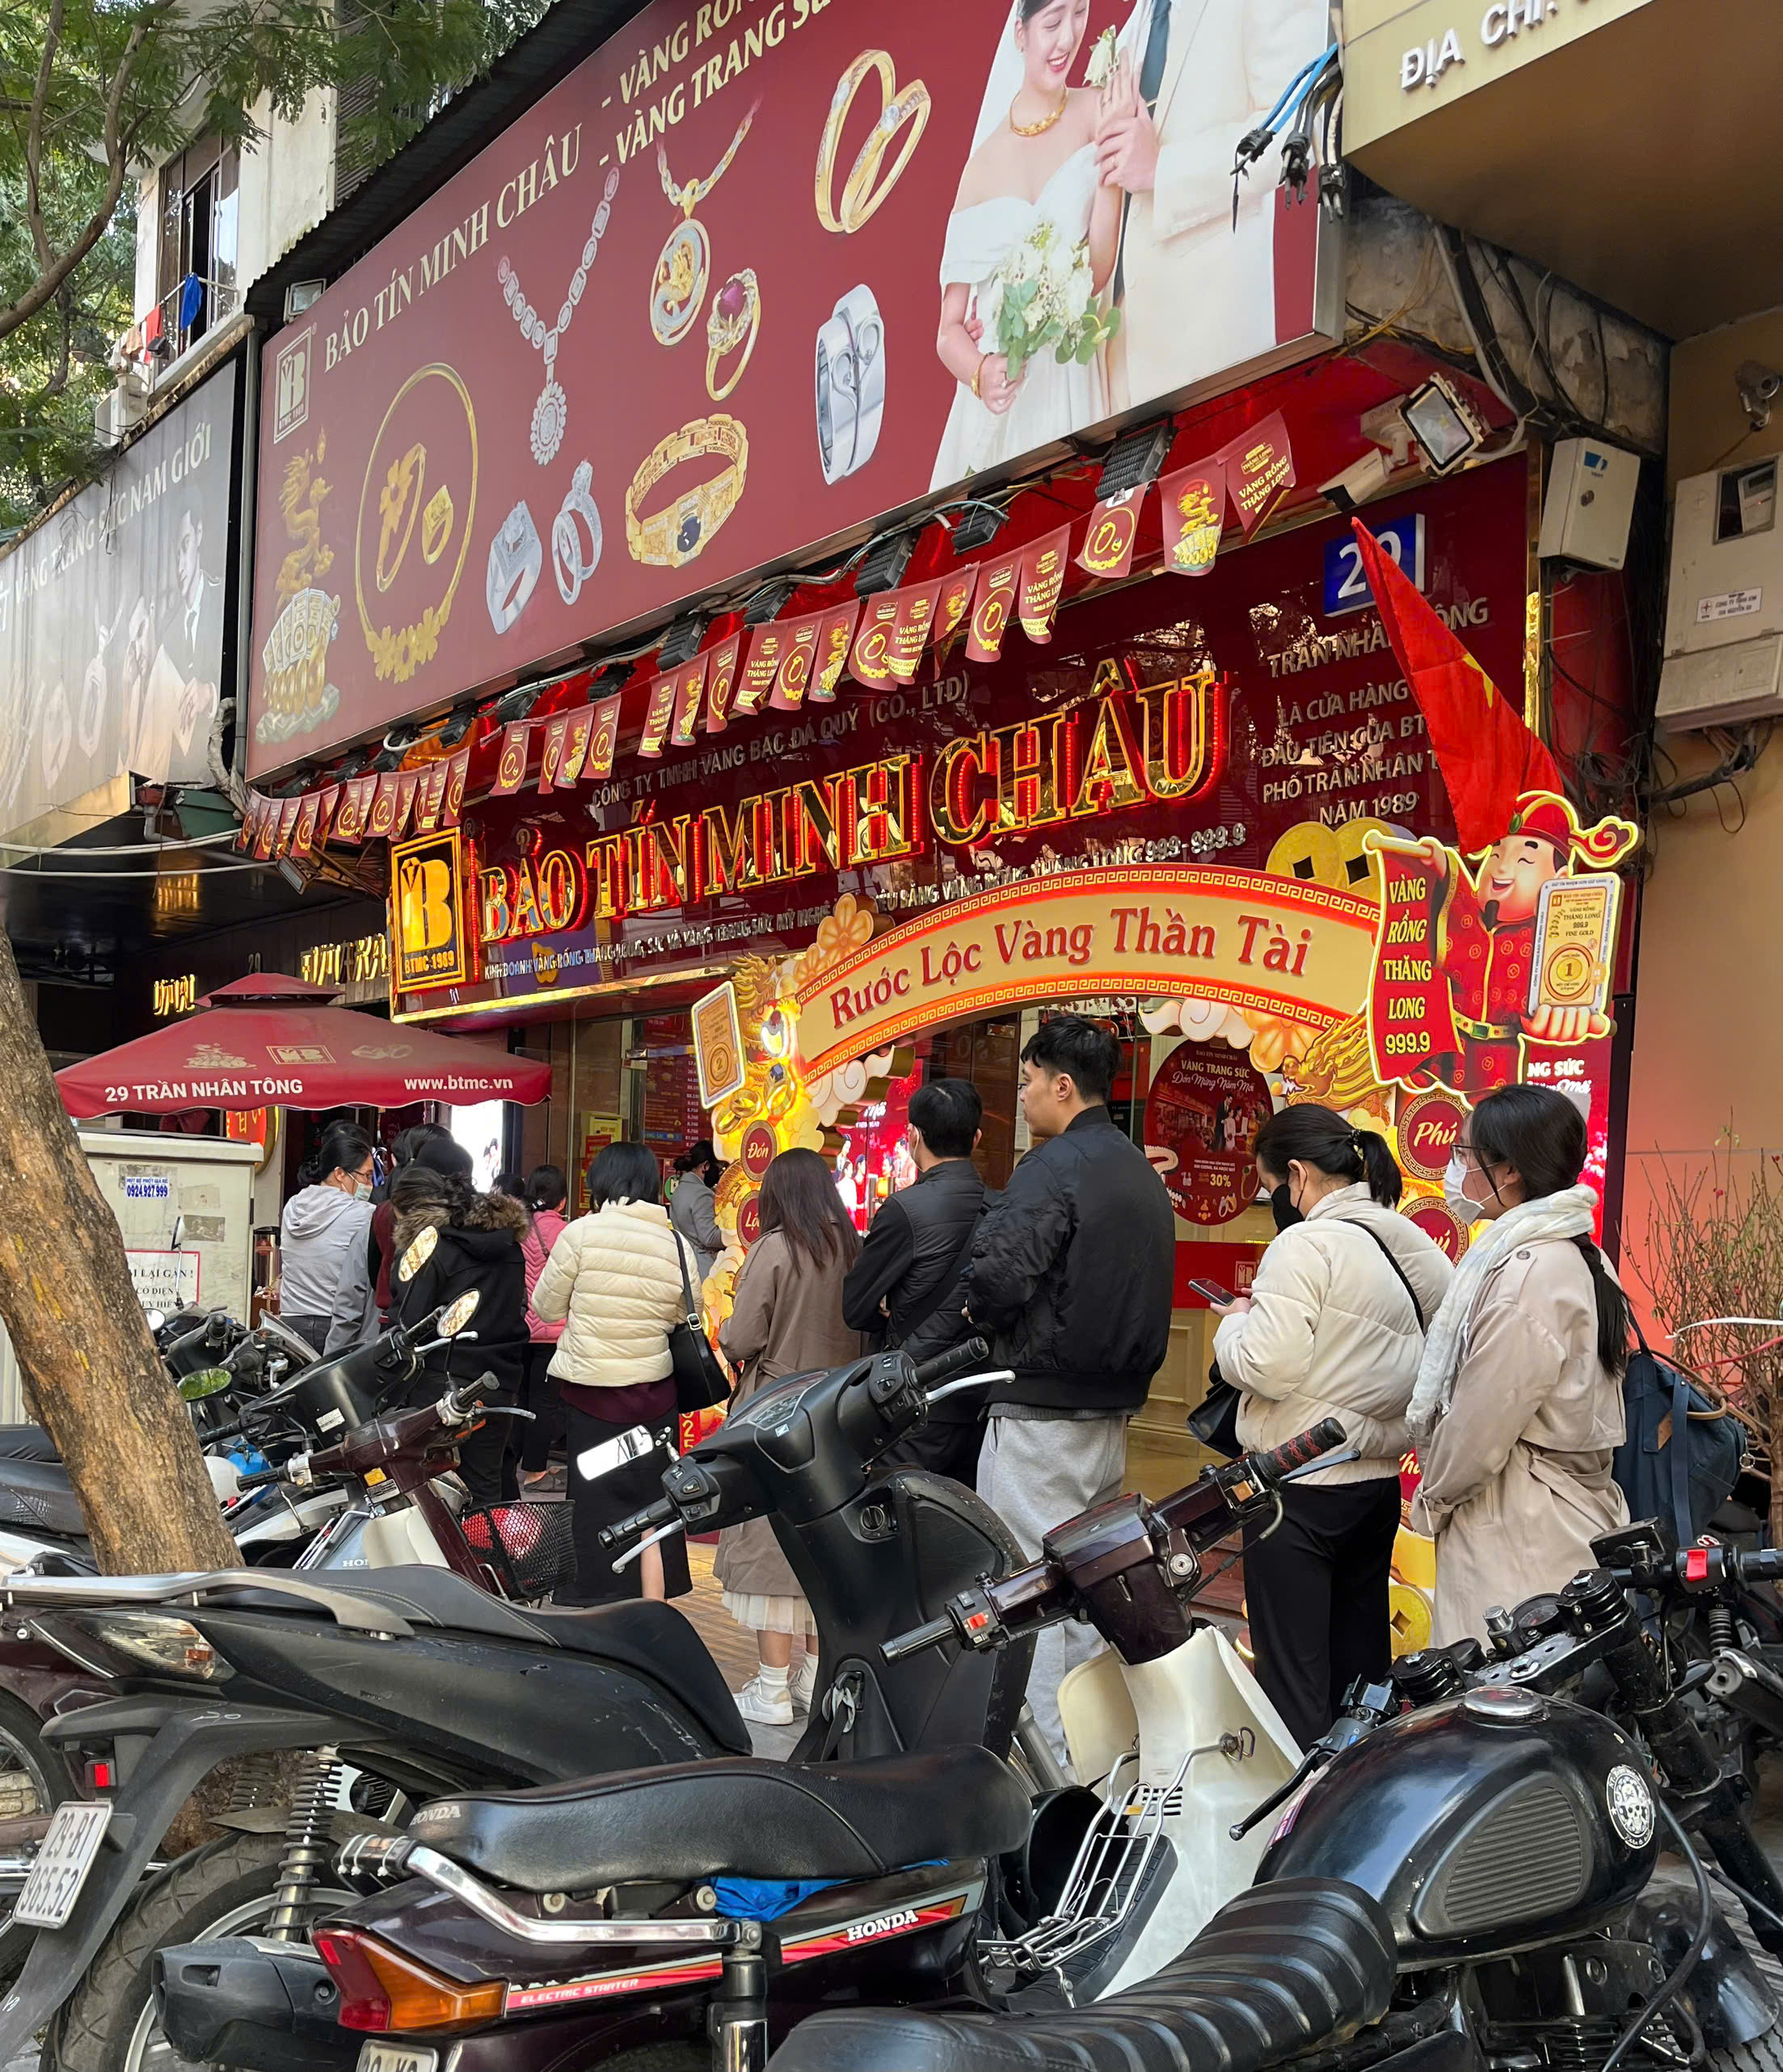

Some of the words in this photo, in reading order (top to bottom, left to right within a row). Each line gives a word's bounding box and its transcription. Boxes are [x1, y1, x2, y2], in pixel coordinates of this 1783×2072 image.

[620, 20, 689, 104] VÀNG
[1399, 28, 1465, 91] ĐỊA
[616, 82, 685, 164] VÀNG
[691, 2, 786, 108] TRANG
[324, 307, 369, 373] BẢO
[373, 265, 414, 331] TÍN
[419, 200, 491, 297] MINH
[496, 122, 583, 228] CHÂU
[130, 460, 167, 517] NAM
[171, 423, 212, 484] GIỚI
[1238, 476, 1265, 499] VÀNG
[1265, 455, 1287, 480] RỒNG
[1241, 484, 1271, 511] THĂNG
[1271, 463, 1290, 487] LONG
[1024, 590, 1051, 604] THĂNG
[1051, 583, 1061, 596] LON
[1027, 580, 1048, 594] VÀNG
[895, 634, 918, 644] THĂNG
[899, 625, 917, 635] VÀNG
[1267, 634, 1329, 678] TRẦN
[1335, 621, 1392, 660] NHÂ
[1440, 596, 1489, 632] ÔNG
[751, 659, 766, 668] VÀNG
[1281, 701, 1303, 728] LÀ
[1307, 689, 1345, 721] CỬA
[1349, 678, 1408, 712] HÀNG
[592, 779, 631, 808] CÔNG
[634, 773, 651, 796] TY
[660, 764, 697, 789] TNHH
[750, 735, 784, 764] BẠC
[820, 706, 860, 738] QUÝ
[922, 672, 969, 709] LTD)
[1305, 726, 1351, 757] TIÊN
[1401, 713, 1427, 738] BT
[1263, 773, 1303, 803] PHỐ
[1304, 764, 1359, 794] TRẦN
[1363, 752, 1423, 783] NHÂN
[480, 828, 576, 942] BẢO
[586, 800, 692, 919] TÍN
[703, 753, 913, 895] MINH
[930, 658, 1216, 845] CHÂU
[1319, 798, 1366, 825] NĂM
[1372, 791, 1418, 819] 1989
[1191, 823, 1246, 854] 999.9
[1389, 877, 1426, 904] VÀNG
[1386, 916, 1426, 944] RỒNG
[405, 955, 430, 975] BTMC
[431, 950, 455, 970] 1989
[485, 963, 503, 980] KINH
[503, 959, 533, 977] DOANH
[533, 954, 556, 972] VÀNG
[557, 946, 584, 968] RỒNG
[830, 965, 911, 1030] Rước
[920, 940, 982, 986] Lộc
[994, 920, 1094, 966] Vàng
[1110, 905, 1216, 959] Thần
[1237, 914, 1314, 976] Tài
[1383, 955, 1431, 982] THĂNG
[1565, 962, 1573, 977] 1
[1388, 996, 1425, 1020] LONG
[1385, 1030, 1431, 1055] 999.9
[1181, 1059, 1204, 1072] VÀNG
[1206, 1063, 1233, 1076] TRANG
[1234, 1066, 1250, 1078] SỨC
[1553, 1057, 1585, 1076] SỨC
[104, 1085, 129, 1102] 29
[133, 1080, 187, 1101] TRẦN
[192, 1077, 247, 1097] NHÂN
[250, 1076, 303, 1095] TÔNG
[404, 1073, 513, 1092] www.btmc.vn
[1172, 1071, 1191, 1084] Đón
[1191, 1073, 1216, 1091] Mừng
[1217, 1076, 1237, 1090] Năm
[1414, 1121, 1458, 1147] Phú
[748, 1142, 769, 1159] Đón
[127, 1184, 168, 1198] 0924.927.999
[1210, 1173, 1231, 1188] 30%
[745, 1211, 760, 1231] Lộ
[141, 1269, 159, 1280] LẠI
[410, 1805, 462, 1826] HONDA
[20, 1866, 79, 1917] 965.52
[846, 1908, 919, 1943] HONDA
[521, 1986, 580, 2004] ELECTRIC
[583, 1977, 639, 1996] STARTER
